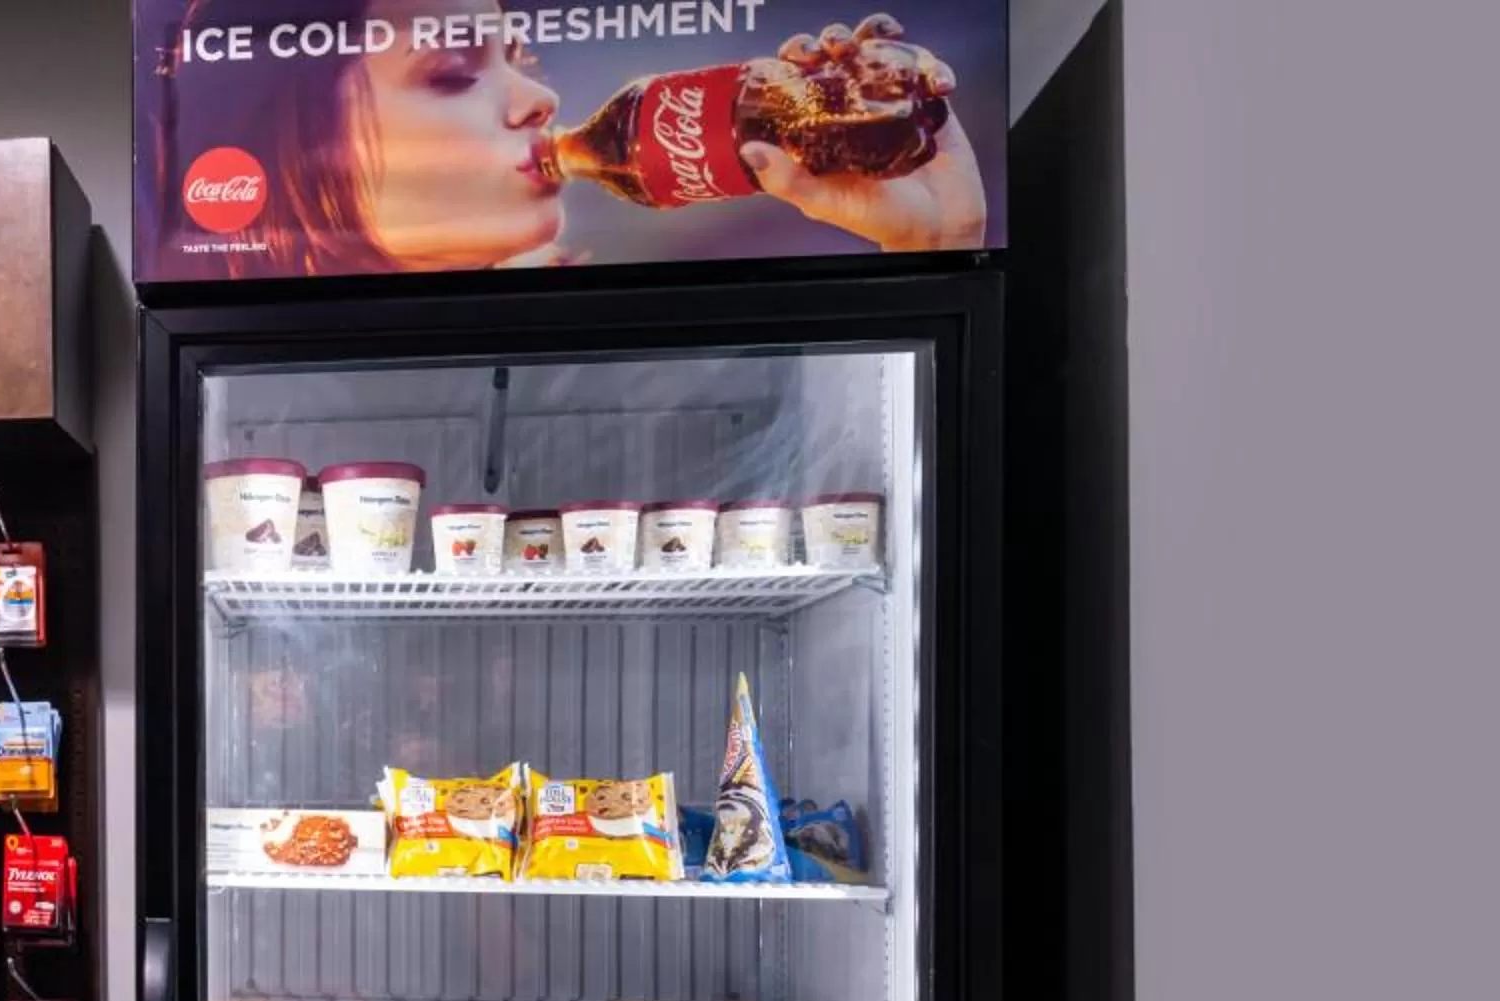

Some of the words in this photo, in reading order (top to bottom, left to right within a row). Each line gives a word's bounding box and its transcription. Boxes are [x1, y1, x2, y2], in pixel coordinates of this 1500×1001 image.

[182, 26, 253, 62] ICE
[269, 22, 395, 58] COLD
[413, 0, 763, 51] REFRESHMENT
